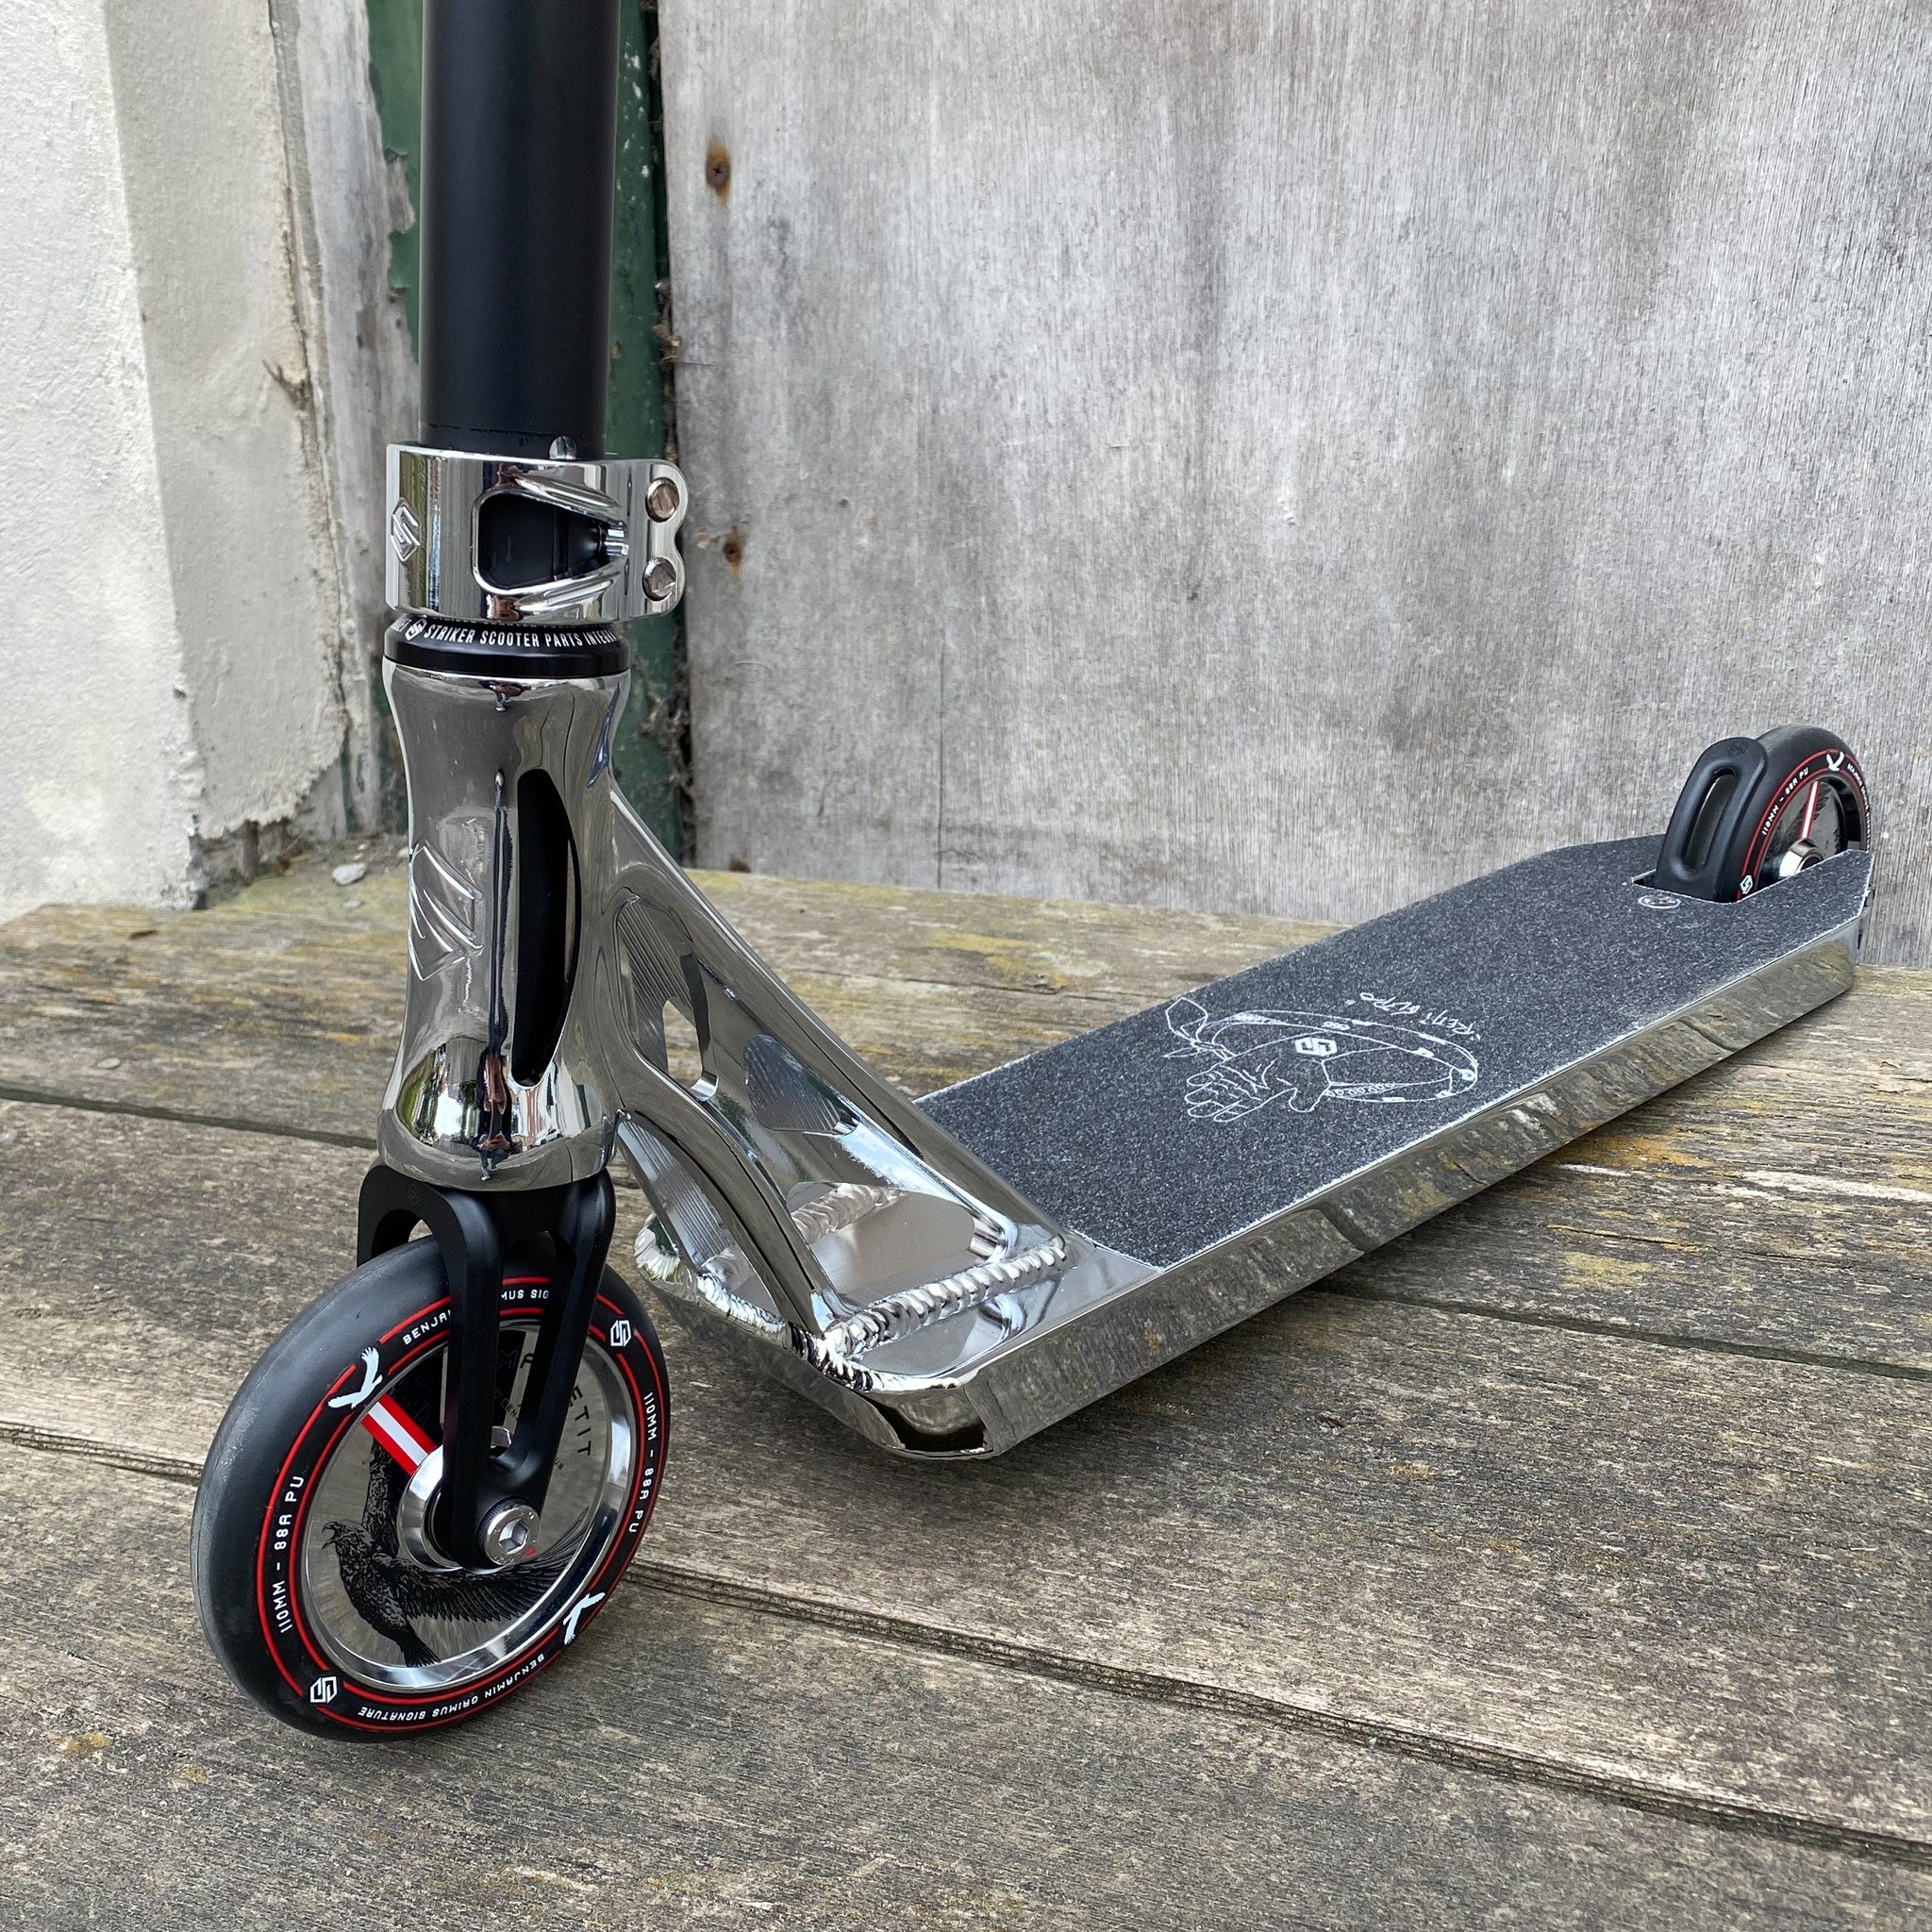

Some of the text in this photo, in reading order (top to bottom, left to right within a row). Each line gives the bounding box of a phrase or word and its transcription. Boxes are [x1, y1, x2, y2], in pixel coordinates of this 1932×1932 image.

[425, 624, 475, 643] STRIKER
[479, 632, 541, 648] SCOOTER
[545, 632, 583, 648] PARTS
[402, 1309, 451, 1345] BENJA
[643, 1391, 658, 1441] 110MM
[284, 1475, 305, 1502] PU
[640, 1467, 654, 1500] 88A
[274, 1514, 292, 1551] 88A
[628, 1509, 644, 1533] PU
[272, 1580, 293, 1633] 110MM
[358, 1653, 545, 1722] BENJAMIN GRIMUS SIGNATURE
